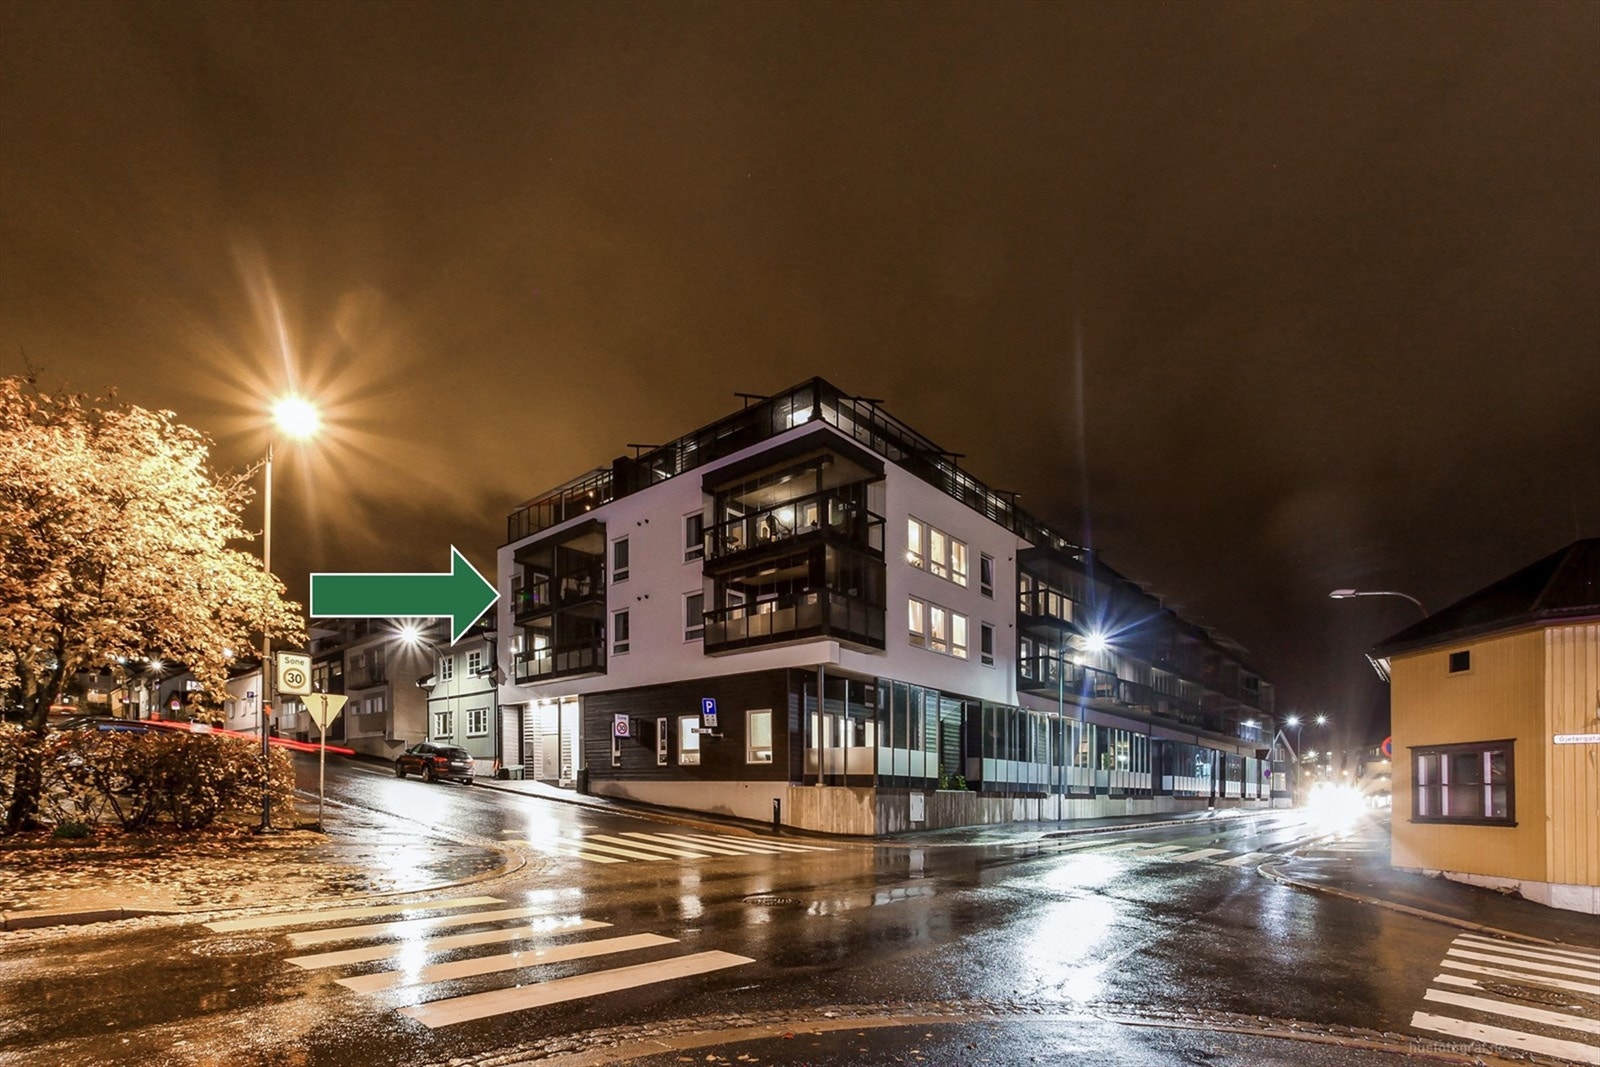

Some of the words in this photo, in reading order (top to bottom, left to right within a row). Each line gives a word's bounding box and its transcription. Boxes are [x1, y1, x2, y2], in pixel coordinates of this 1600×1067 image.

[284, 656, 305, 666] Sone
[287, 672, 302, 684] 30
[705, 700, 713, 713] P
